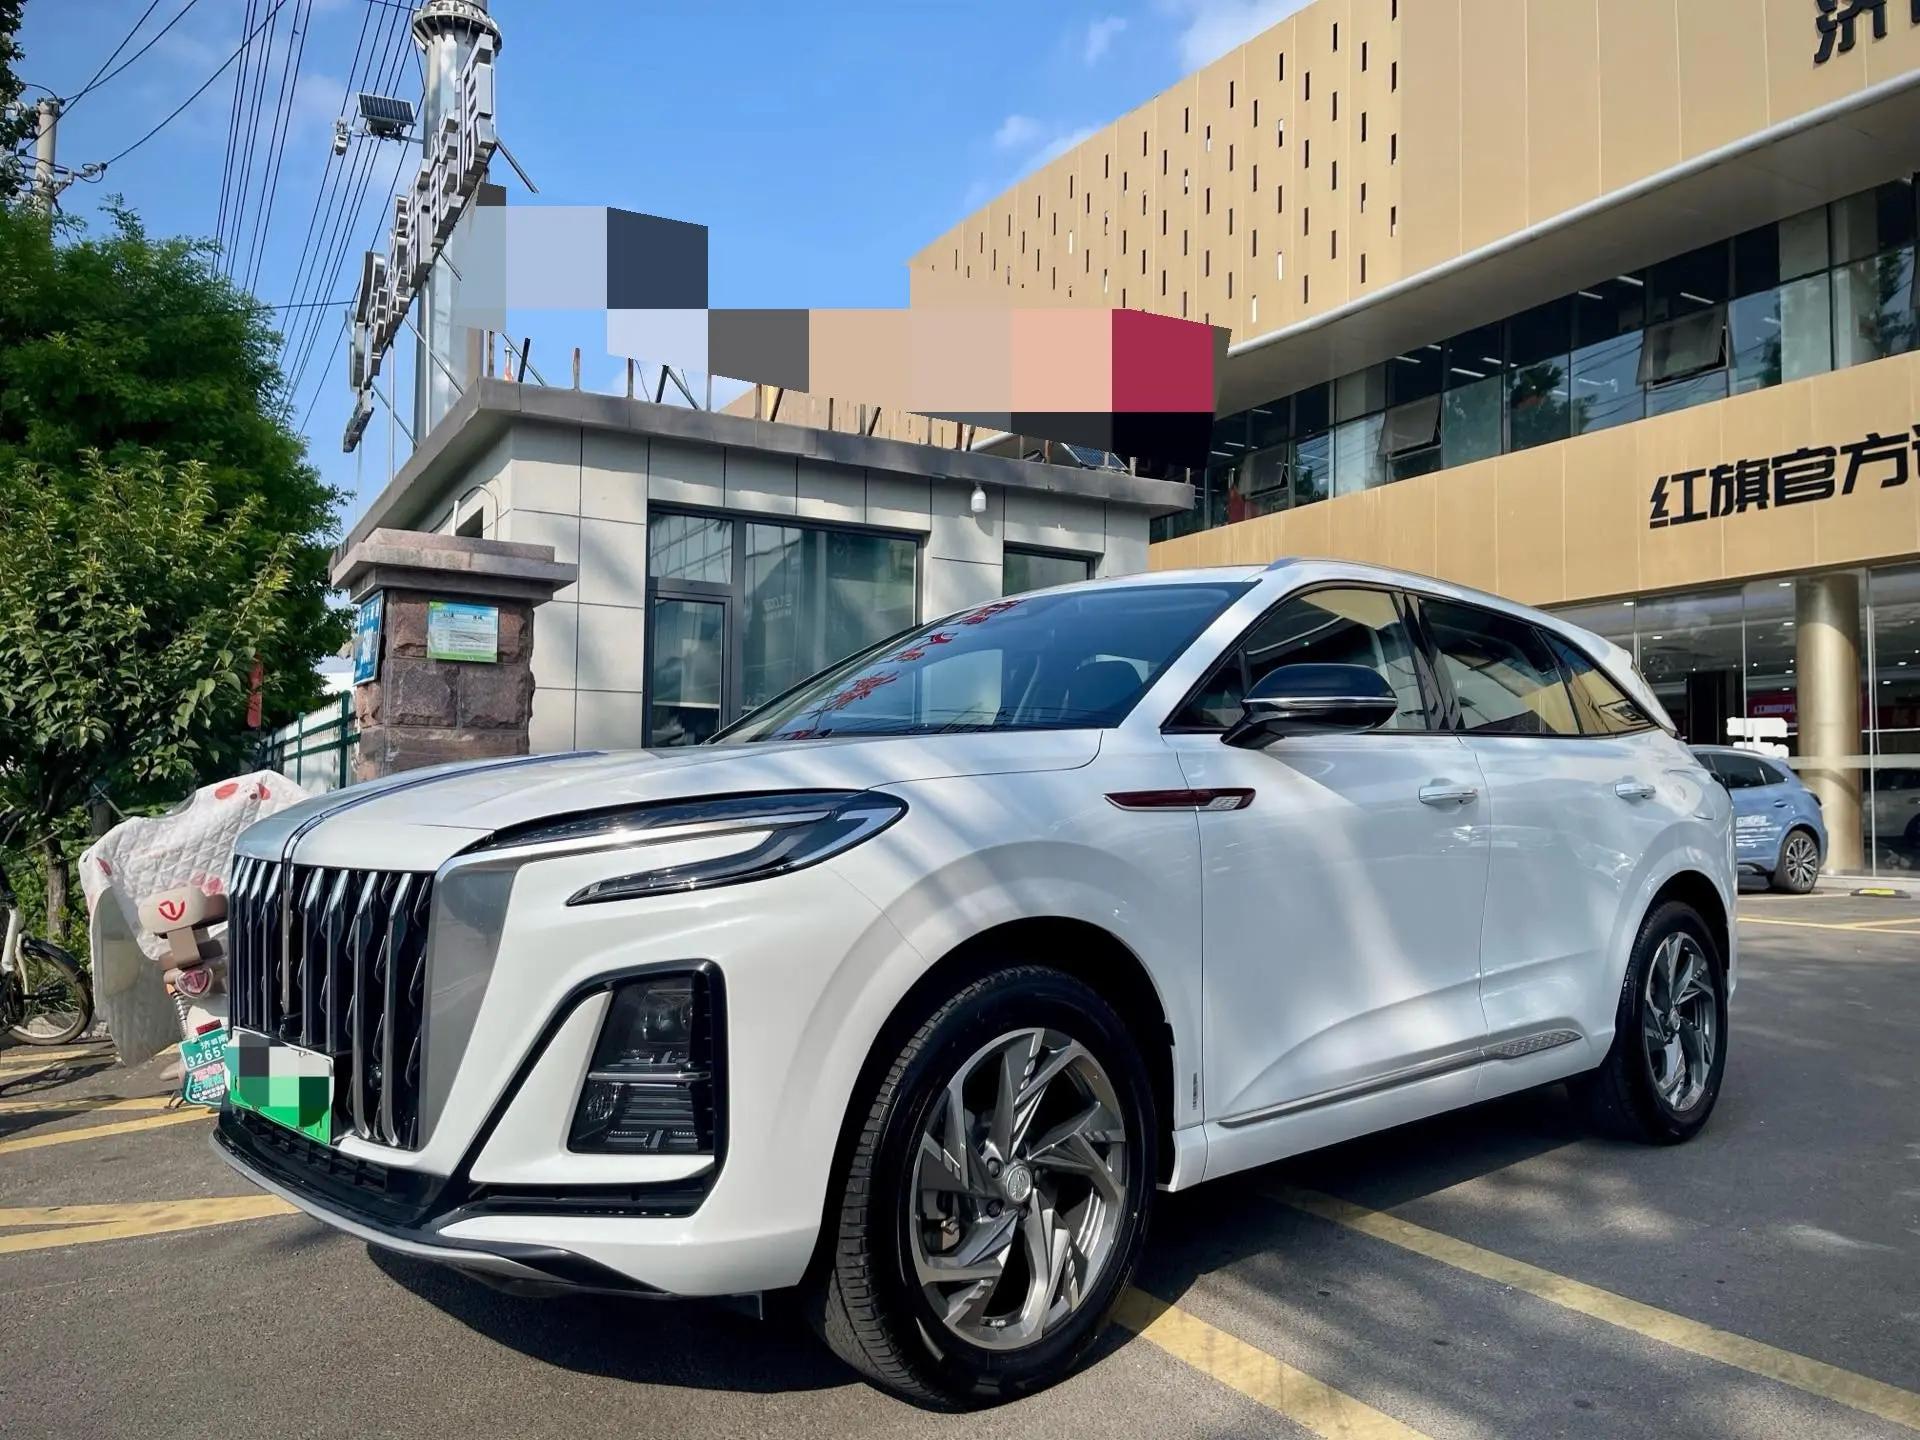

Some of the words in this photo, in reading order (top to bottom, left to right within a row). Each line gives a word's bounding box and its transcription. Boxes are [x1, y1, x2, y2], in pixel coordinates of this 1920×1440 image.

[1814, 0, 1920, 63] 济
[1650, 424, 1920, 529] 红旗官方
